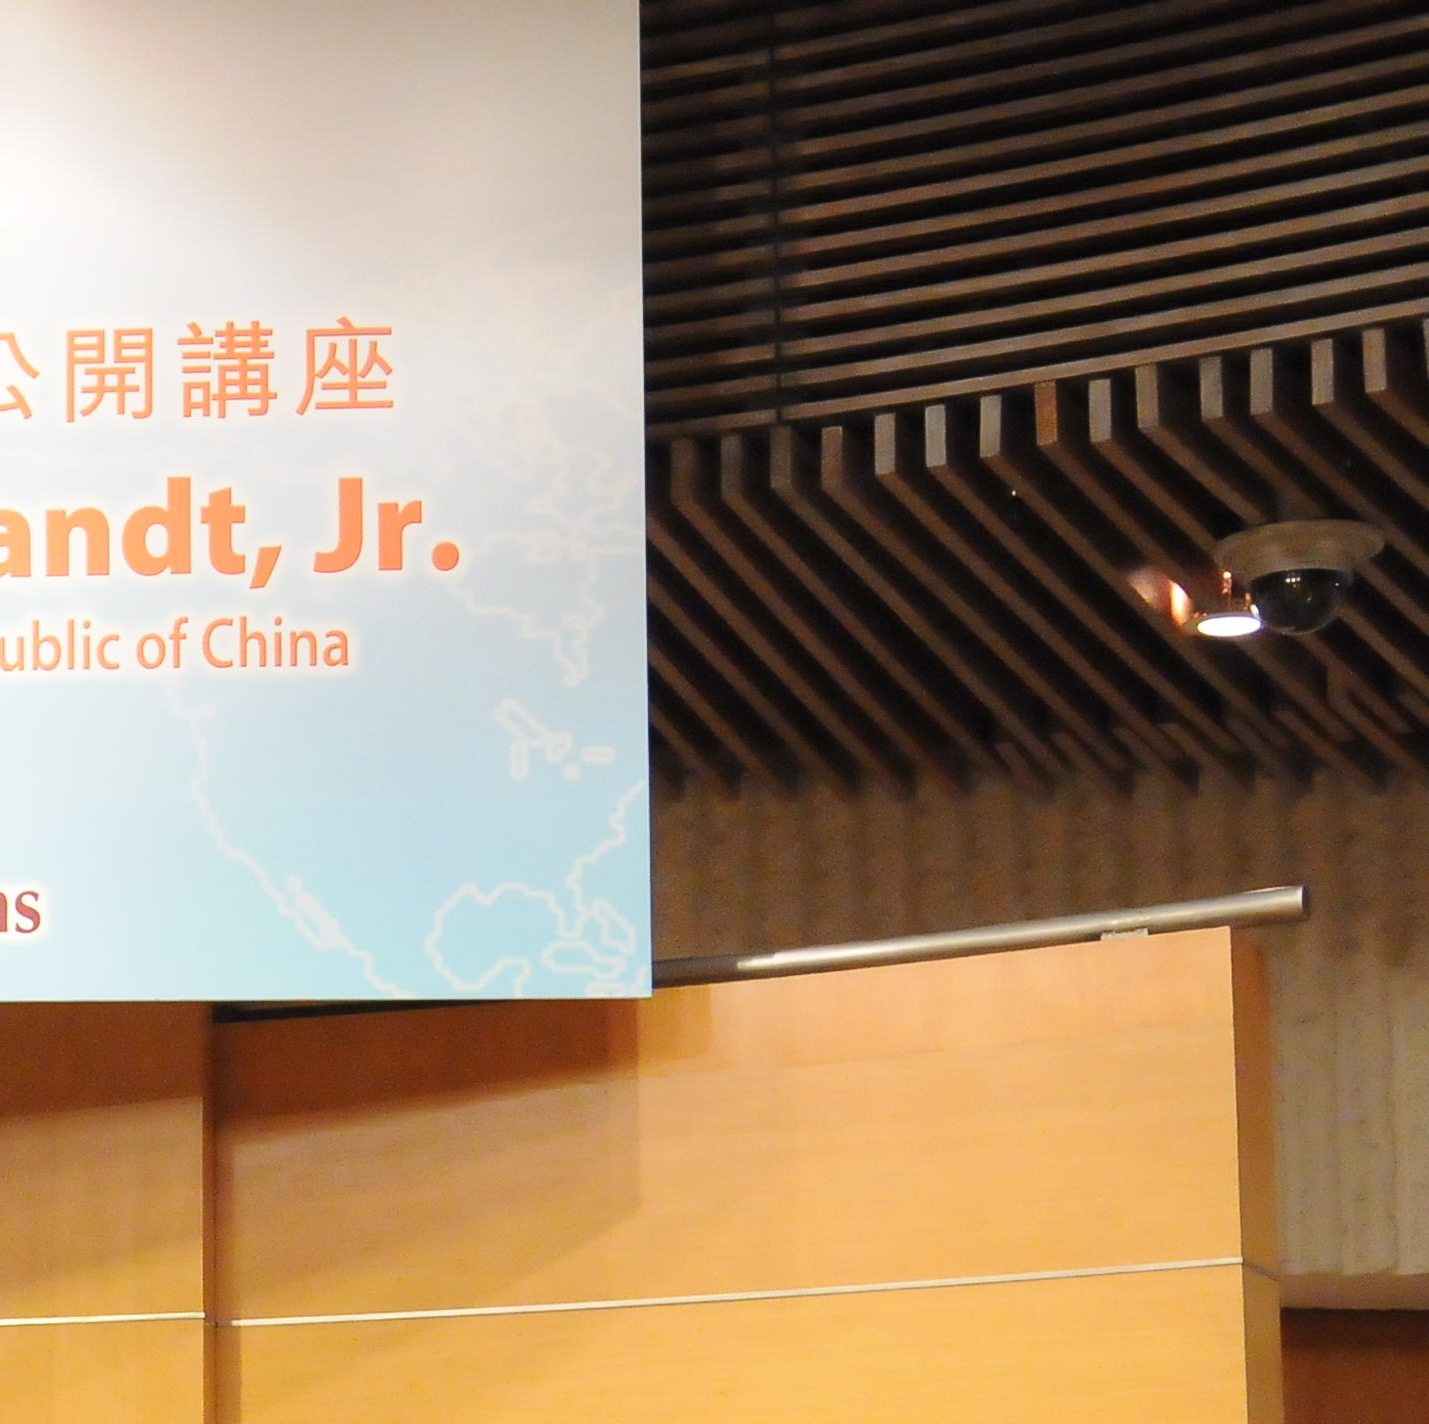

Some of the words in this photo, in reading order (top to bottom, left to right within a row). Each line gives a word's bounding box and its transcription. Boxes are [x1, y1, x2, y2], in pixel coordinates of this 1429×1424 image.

[313, 476, 460, 574] Jr.
[136, 615, 189, 670] of
[202, 615, 349, 669] China
